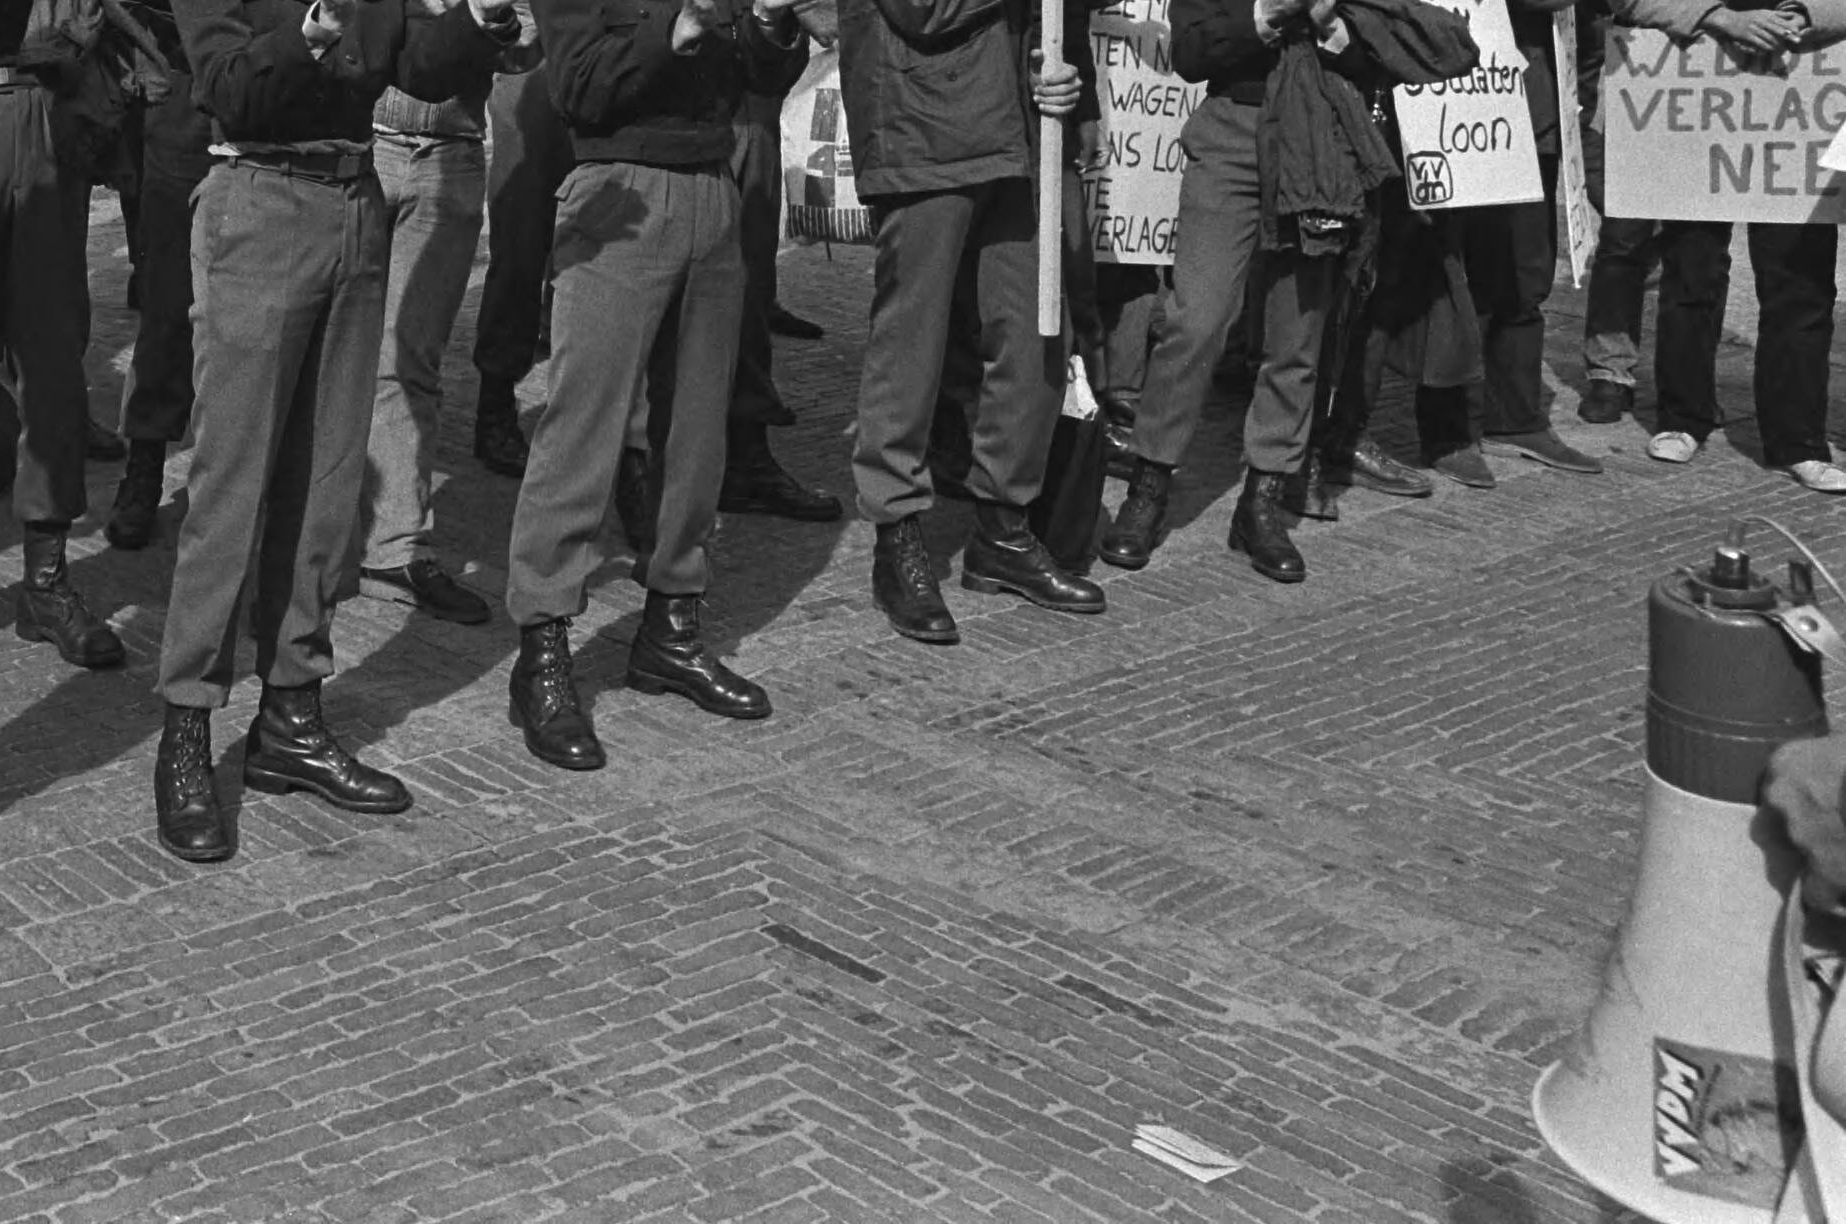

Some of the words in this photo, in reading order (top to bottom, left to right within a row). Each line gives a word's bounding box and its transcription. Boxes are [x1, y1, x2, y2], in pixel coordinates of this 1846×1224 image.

[1108, 78, 1198, 118] WAGEN
[1619, 82, 1846, 133] VERLAG
[1655, 1049, 1703, 1176] VVDM
